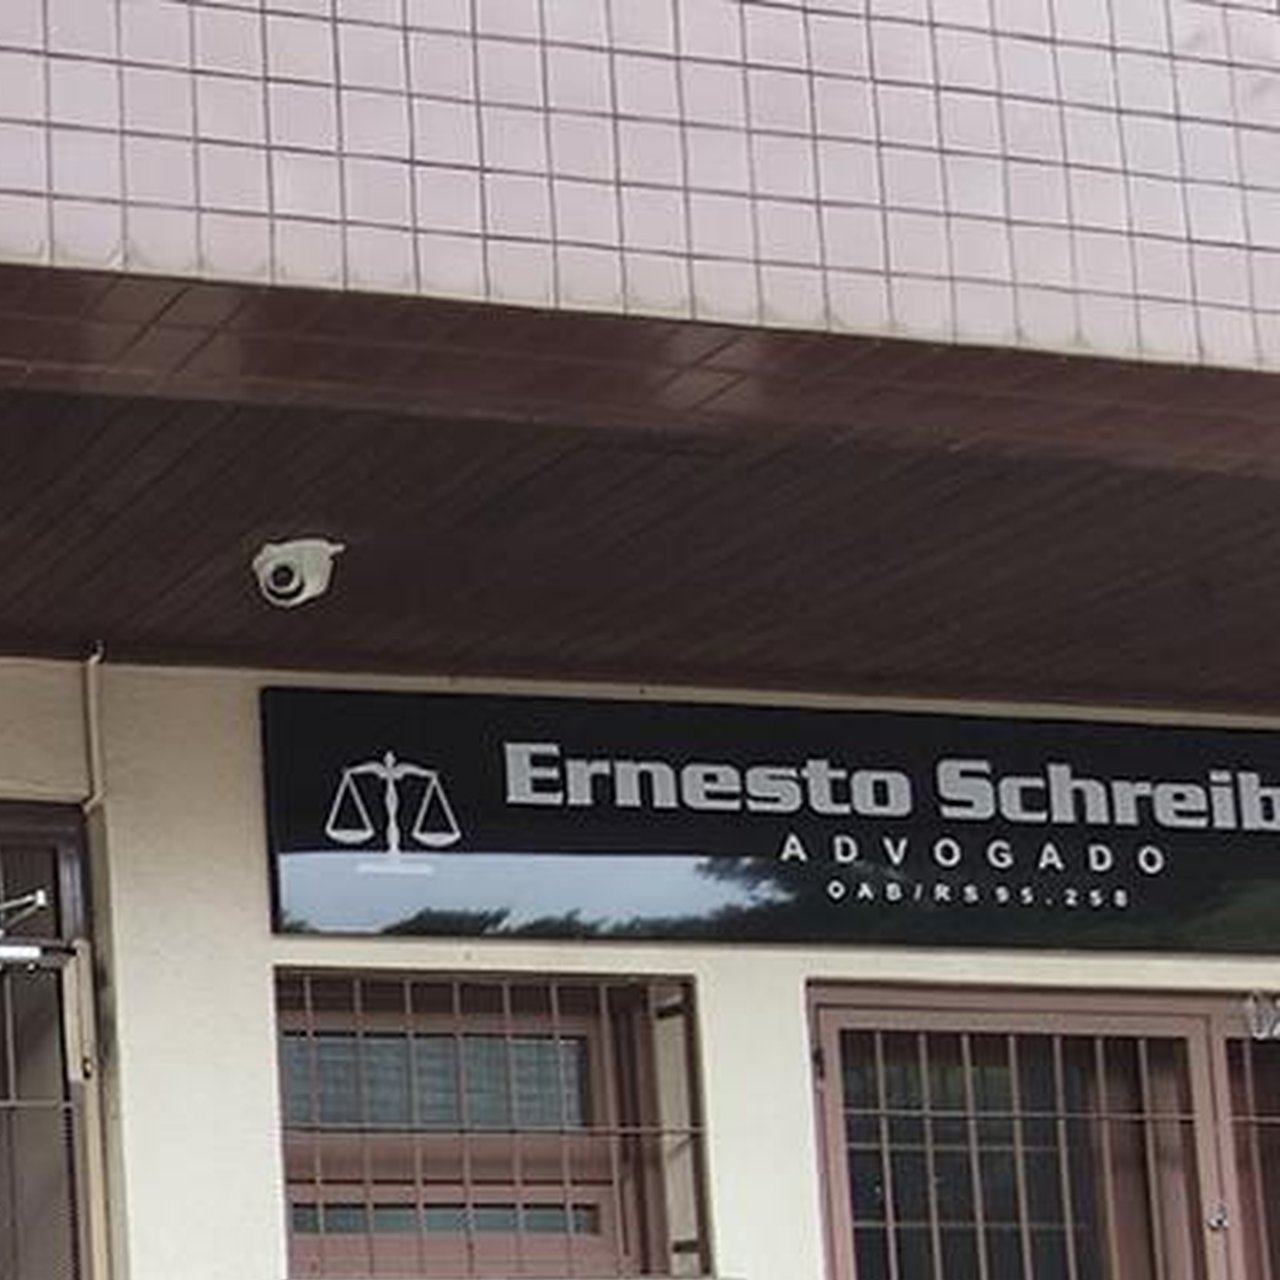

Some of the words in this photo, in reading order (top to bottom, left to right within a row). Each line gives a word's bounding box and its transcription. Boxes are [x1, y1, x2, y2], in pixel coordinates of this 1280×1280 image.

[503, 740, 913, 817] Ernesto
[936, 758, 1280, 830] Schreib
[780, 834, 1164, 875] ADVOGADO
